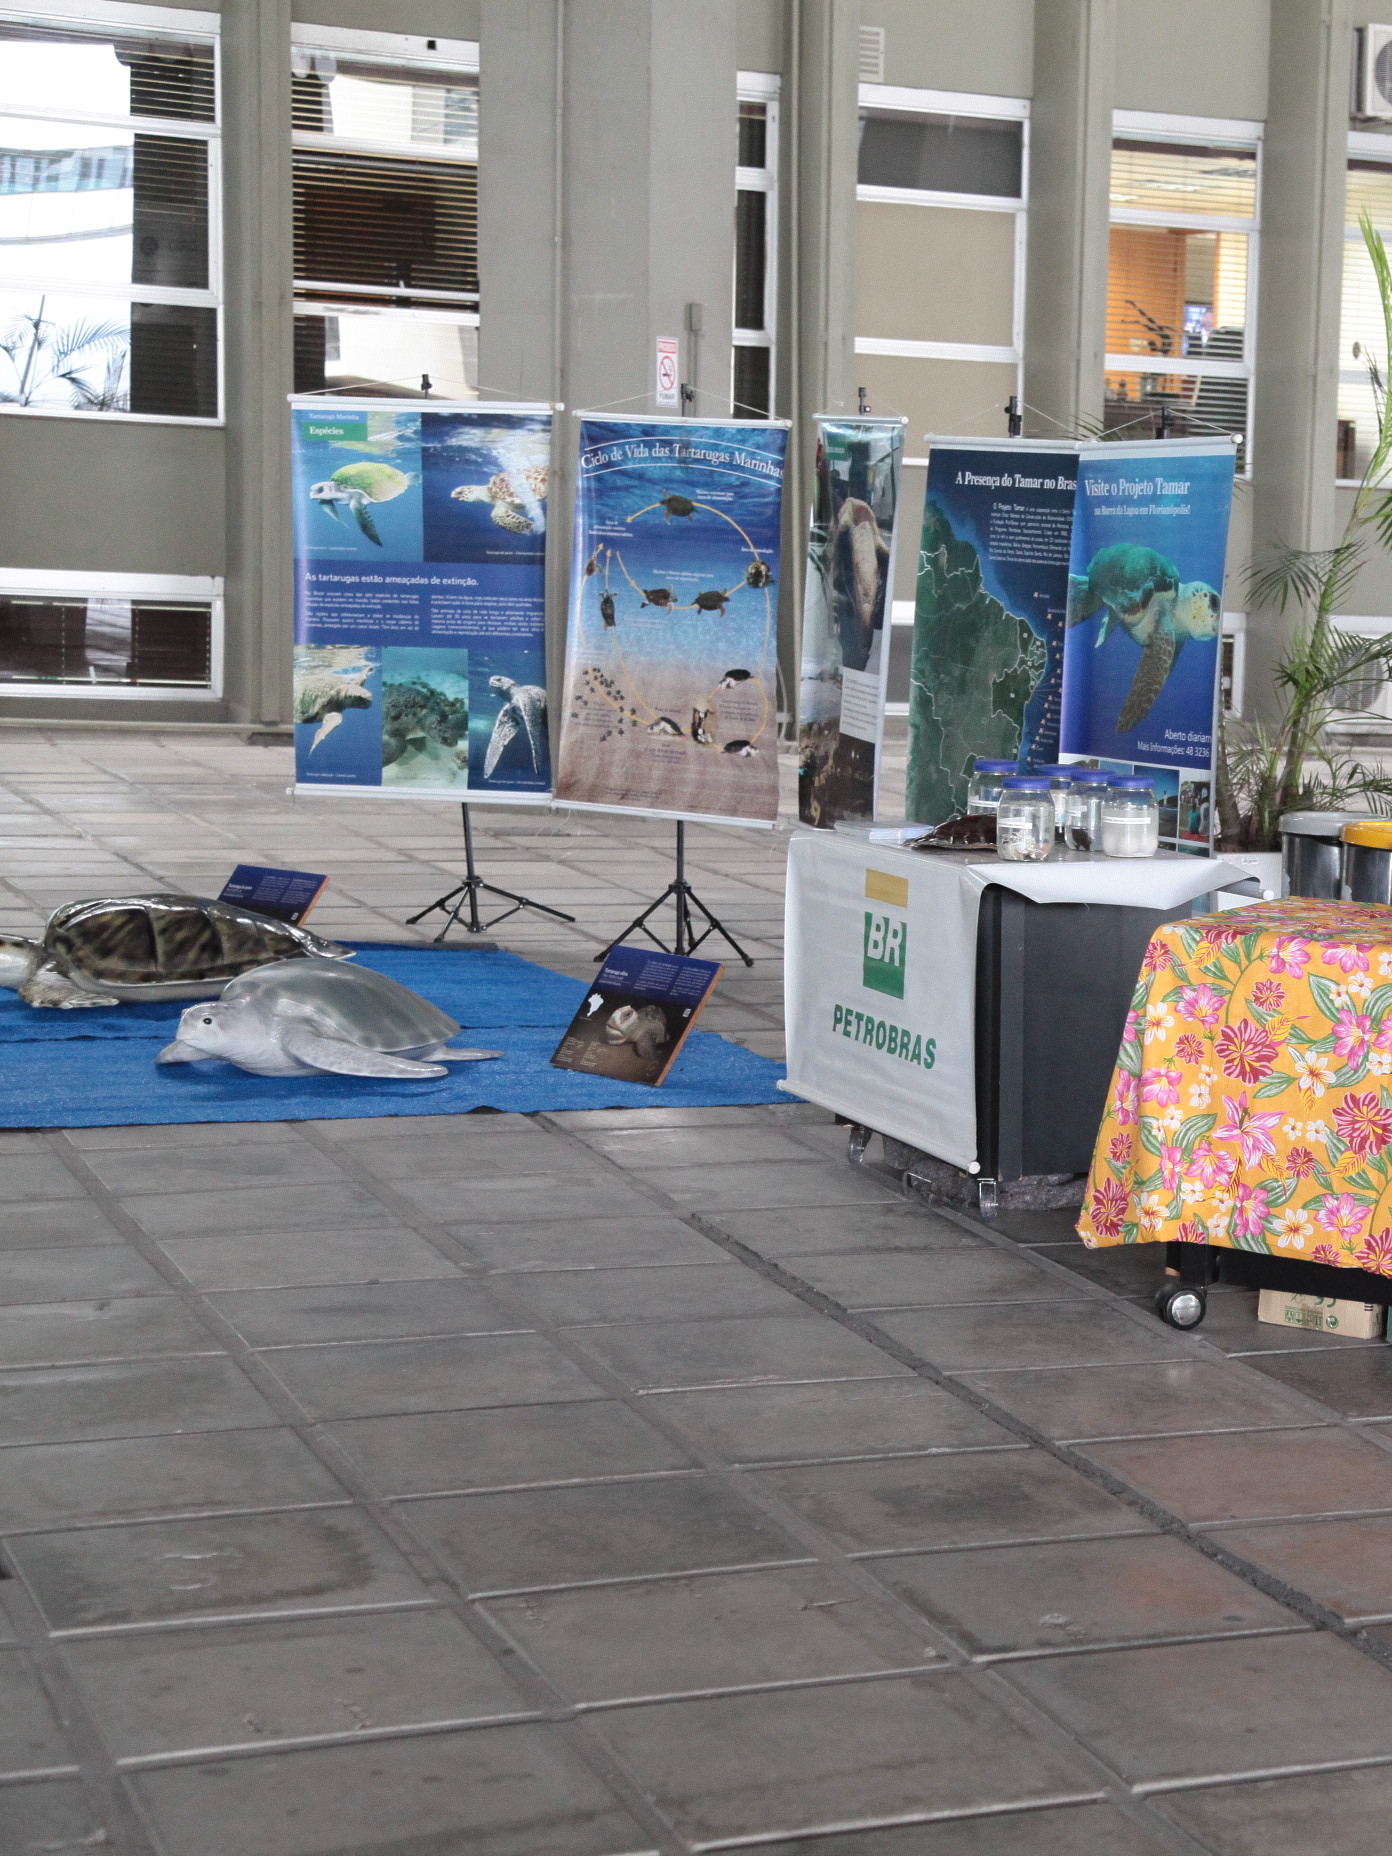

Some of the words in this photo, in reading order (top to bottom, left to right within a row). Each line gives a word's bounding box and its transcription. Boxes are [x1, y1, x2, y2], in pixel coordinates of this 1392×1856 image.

[309, 426, 344, 436] Espécies
[580, 452, 609, 469] Ciclo
[610, 447, 623, 460] de
[625, 444, 649, 458] Vida
[652, 443, 670, 457] das
[672, 443, 730, 465] Tartarugas
[732, 451, 784, 478] Marinhas
[956, 471, 963, 484] A
[965, 472, 1000, 489] Presença
[1001, 473, 1013, 487] do
[1014, 474, 1042, 488] Tamar
[1043, 477, 1056, 489] no
[1084, 479, 1109, 497] Visite
[1111, 482, 1118, 495] o
[1119, 478, 1154, 499] Projeto
[1155, 478, 1191, 495] Tamar
[305, 572, 317, 581] As
[318, 574, 360, 584] tartarugas
[361, 574, 383, 583] estão
[385, 576, 429, 586] ameaçadas
[430, 576, 441, 585] de
[442, 577, 479, 587] extinção.
[1164, 728, 1186, 741] Aberto
[1137, 741, 1149, 751] Mais
[1185, 746, 1194, 755] 48
[867, 914, 903, 967] BR
[833, 1004, 937, 1069] PETROBRAS
